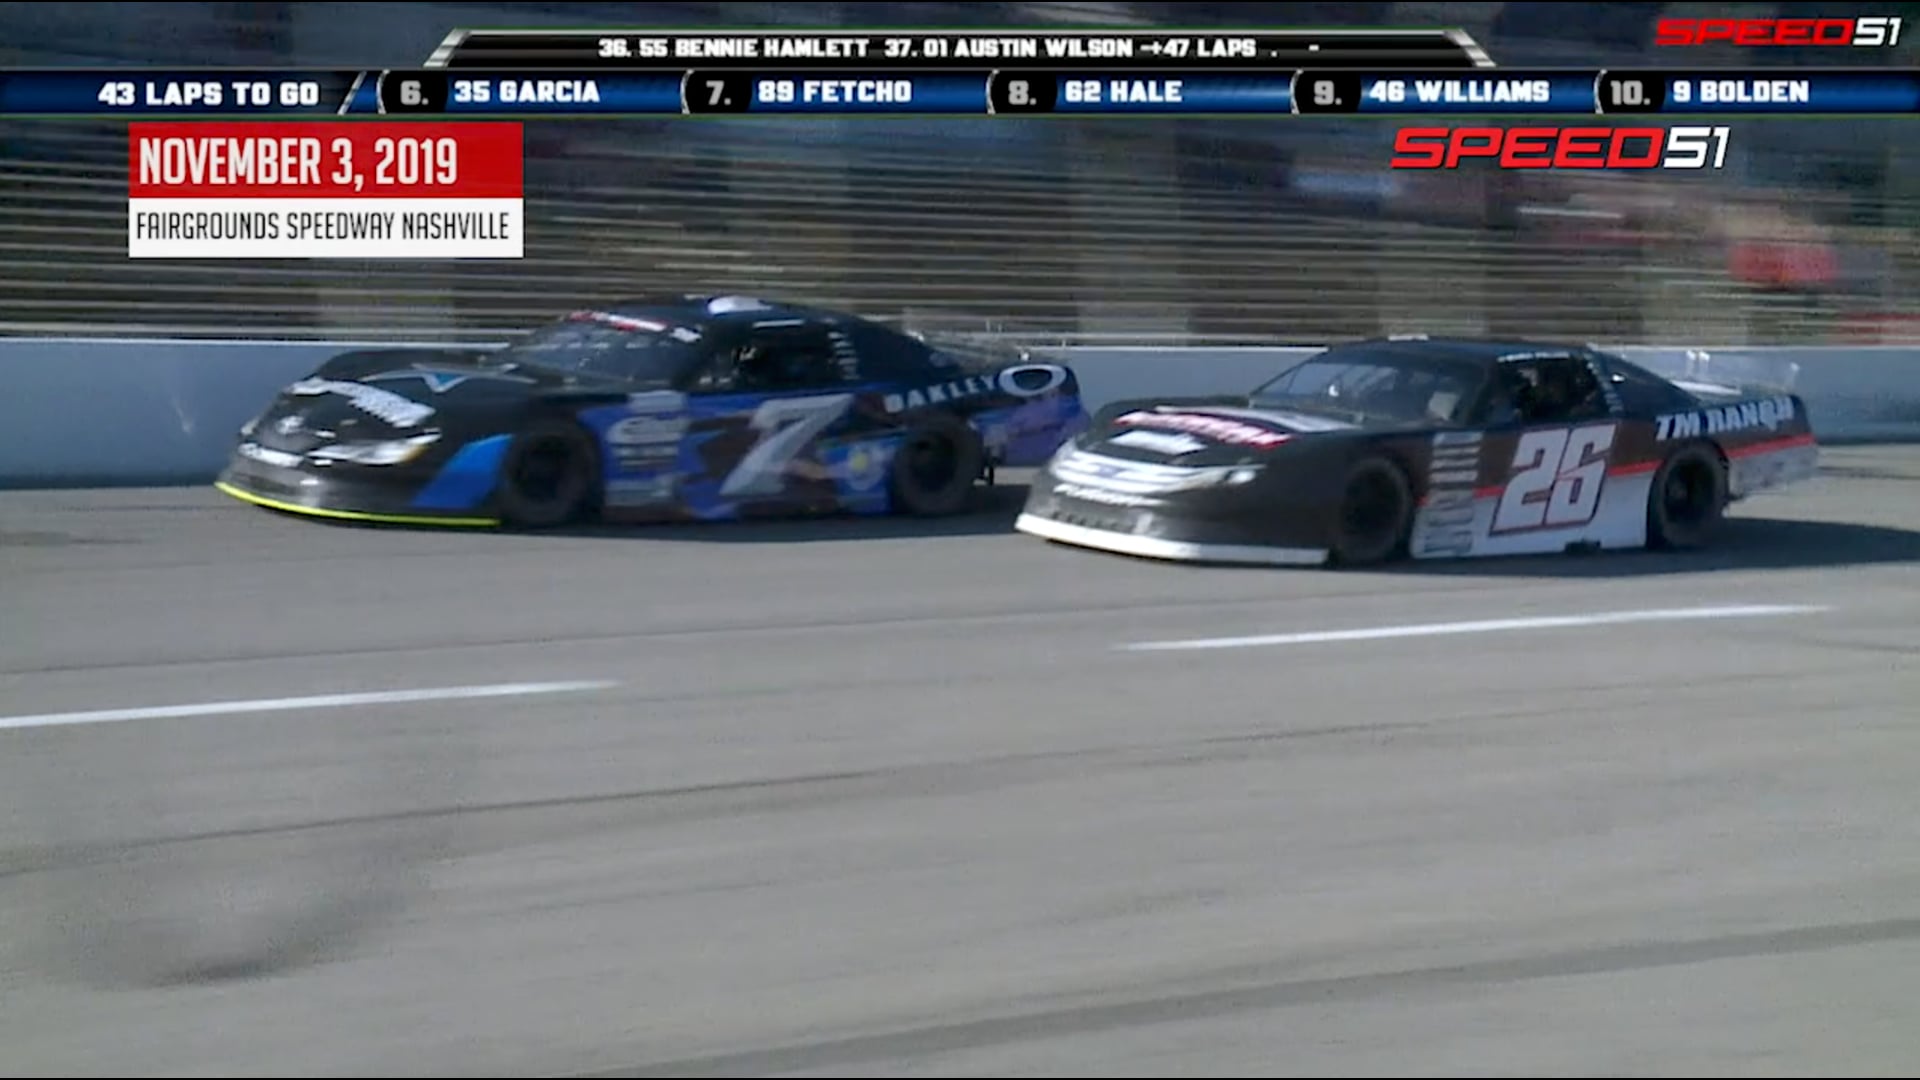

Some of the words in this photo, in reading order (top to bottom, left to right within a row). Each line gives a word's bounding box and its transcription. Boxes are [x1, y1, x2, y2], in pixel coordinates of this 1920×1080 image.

[884, 375, 996, 413] OAKLEY
[1655, 411, 1701, 440] TM
[718, 393, 856, 496] 7
[1488, 422, 1617, 537] 26
